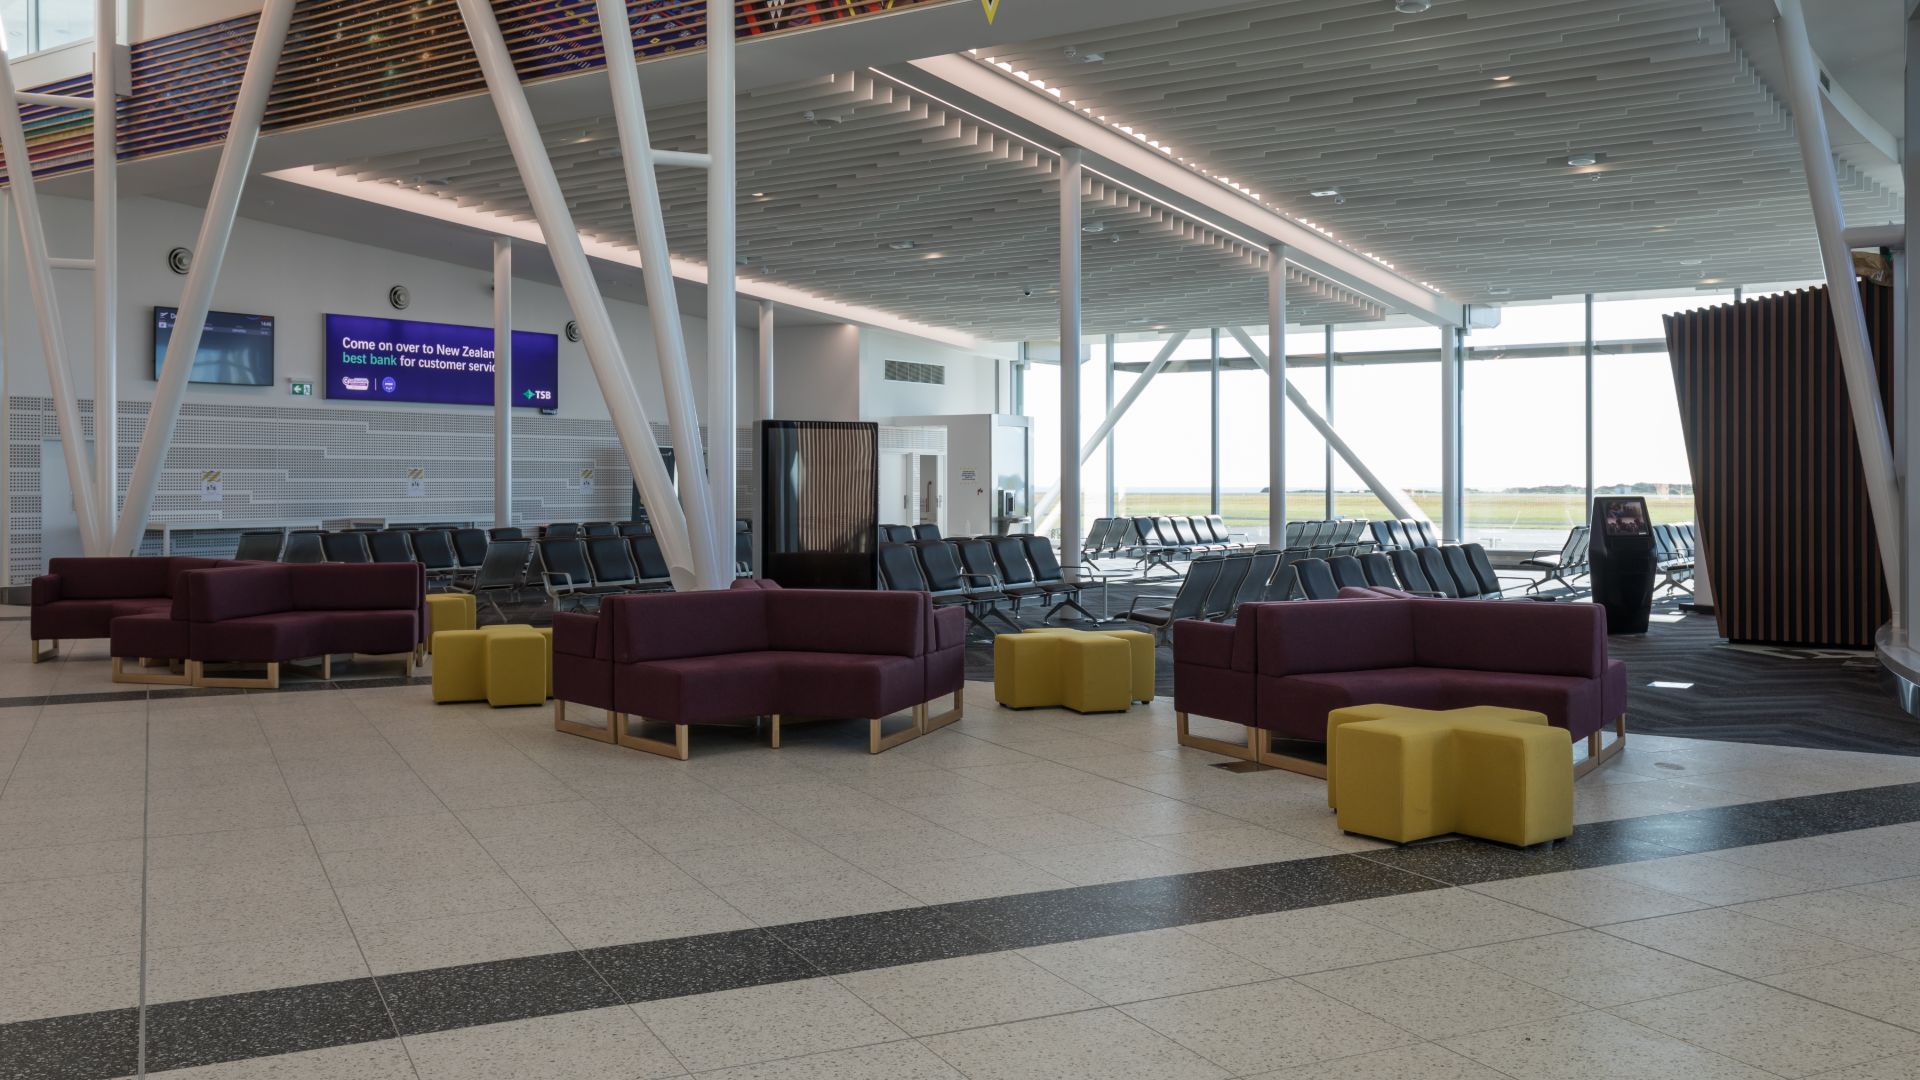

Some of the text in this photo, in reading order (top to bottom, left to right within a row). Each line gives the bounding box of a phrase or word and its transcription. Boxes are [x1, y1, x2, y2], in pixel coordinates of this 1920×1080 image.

[342, 337, 495, 359] Come on over to New Zealan
[342, 352, 495, 372] best bank for customer servic
[535, 390, 552, 400] TSB
